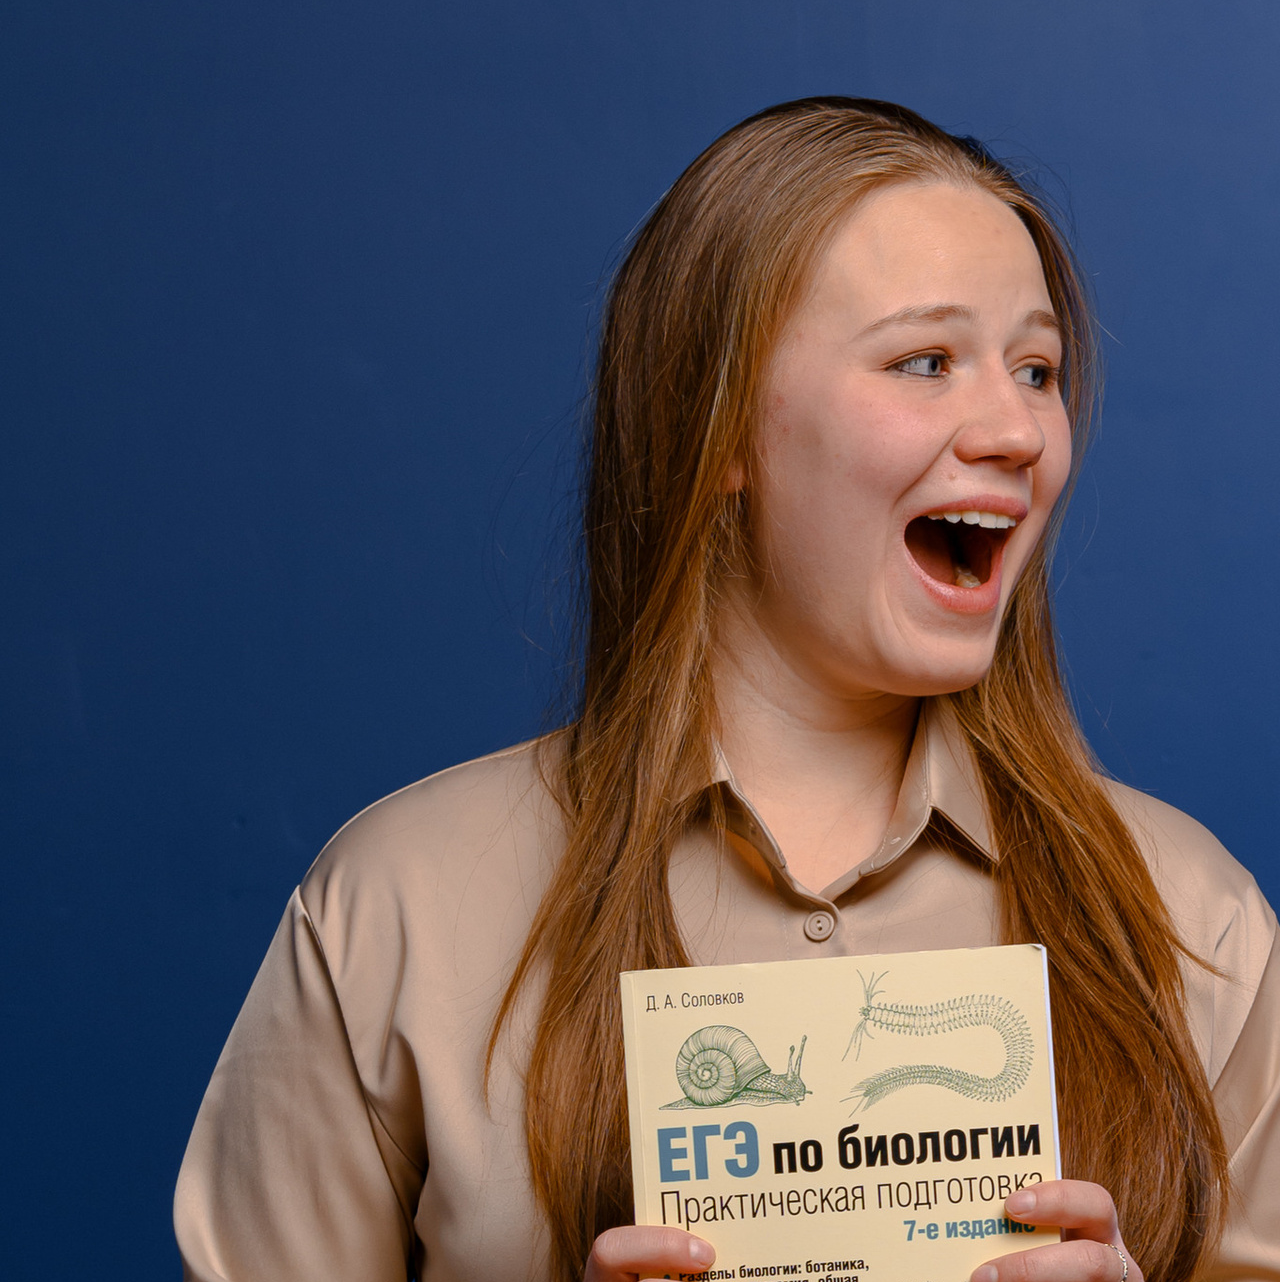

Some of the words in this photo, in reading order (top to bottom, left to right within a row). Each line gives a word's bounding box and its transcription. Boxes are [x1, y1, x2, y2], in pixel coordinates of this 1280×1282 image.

[646, 994, 660, 1012] Д.
[664, 994, 677, 1010] А.
[681, 992, 745, 1008] Соловков
[657, 1121, 760, 1183] ЕГЭ
[773, 1139, 823, 1175] по
[837, 1123, 1041, 1170] биологии
[660, 1185, 866, 1232] Практическая
[903, 1220, 939, 1242] 7-е
[739, 1264, 802, 1278] биологии:
[805, 1259, 869, 1273] ботаника,
